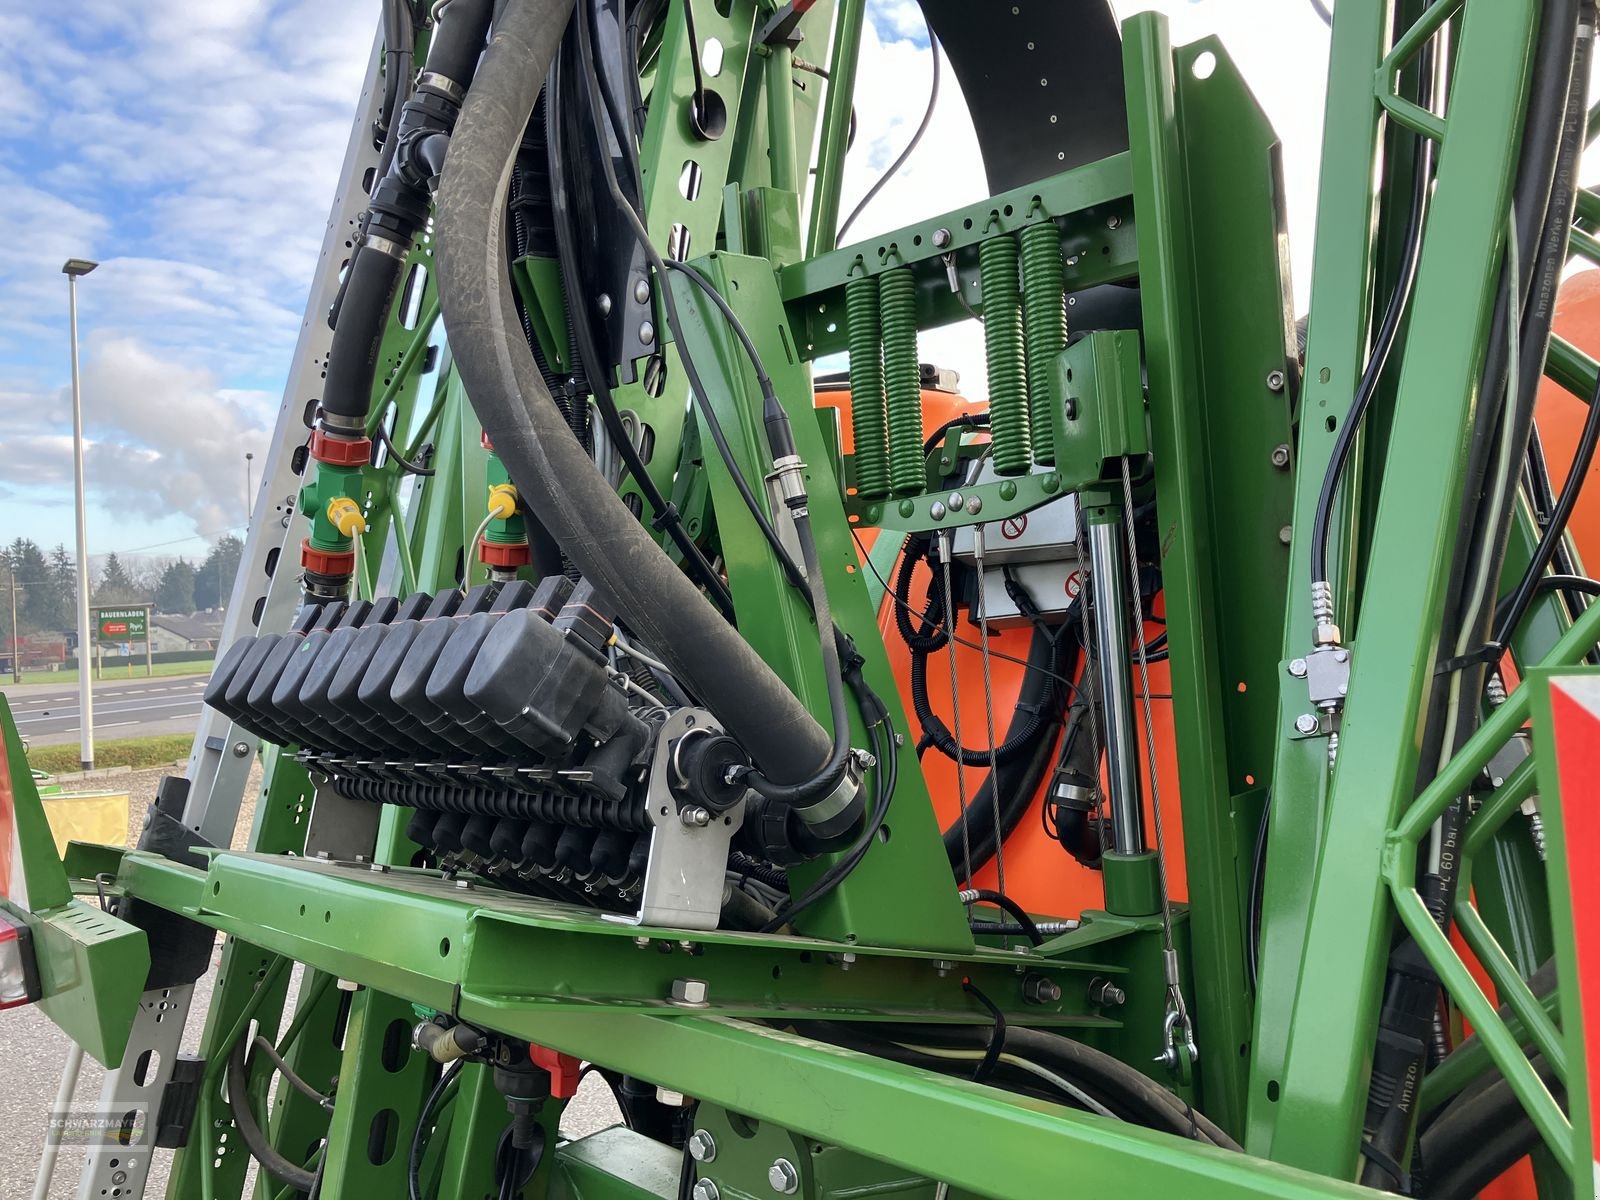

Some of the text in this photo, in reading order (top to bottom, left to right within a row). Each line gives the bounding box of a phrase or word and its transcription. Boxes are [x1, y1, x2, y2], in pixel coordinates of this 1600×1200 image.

[1535, 257, 1555, 319] Amazonen
[1546, 217, 1563, 253] Werke
[100, 610, 144, 618] BAUERNLADEN
[1444, 825, 1458, 848] bar
[1441, 852, 1454, 871] 60
